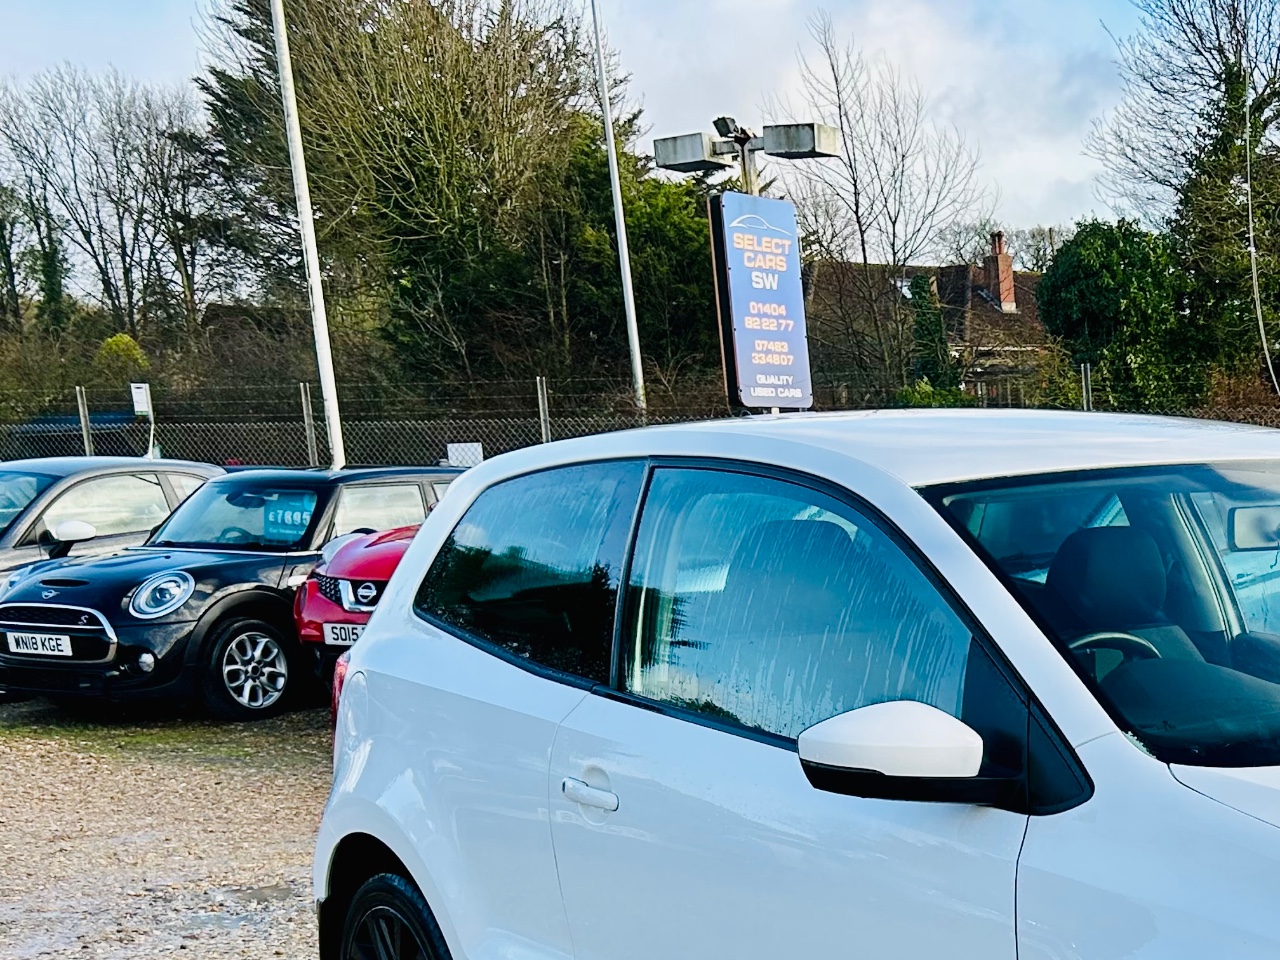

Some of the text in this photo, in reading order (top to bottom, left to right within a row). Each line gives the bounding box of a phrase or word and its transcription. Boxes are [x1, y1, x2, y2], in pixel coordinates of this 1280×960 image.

[733, 232, 792, 255] SELECT
[743, 251, 788, 272] CARS
[751, 271, 779, 291] SW
[749, 301, 787, 316] 01404
[755, 374, 794, 385] QUALITY
[750, 386, 803, 398] USED CARS
[13, 635, 64, 653] WN18 KGE
